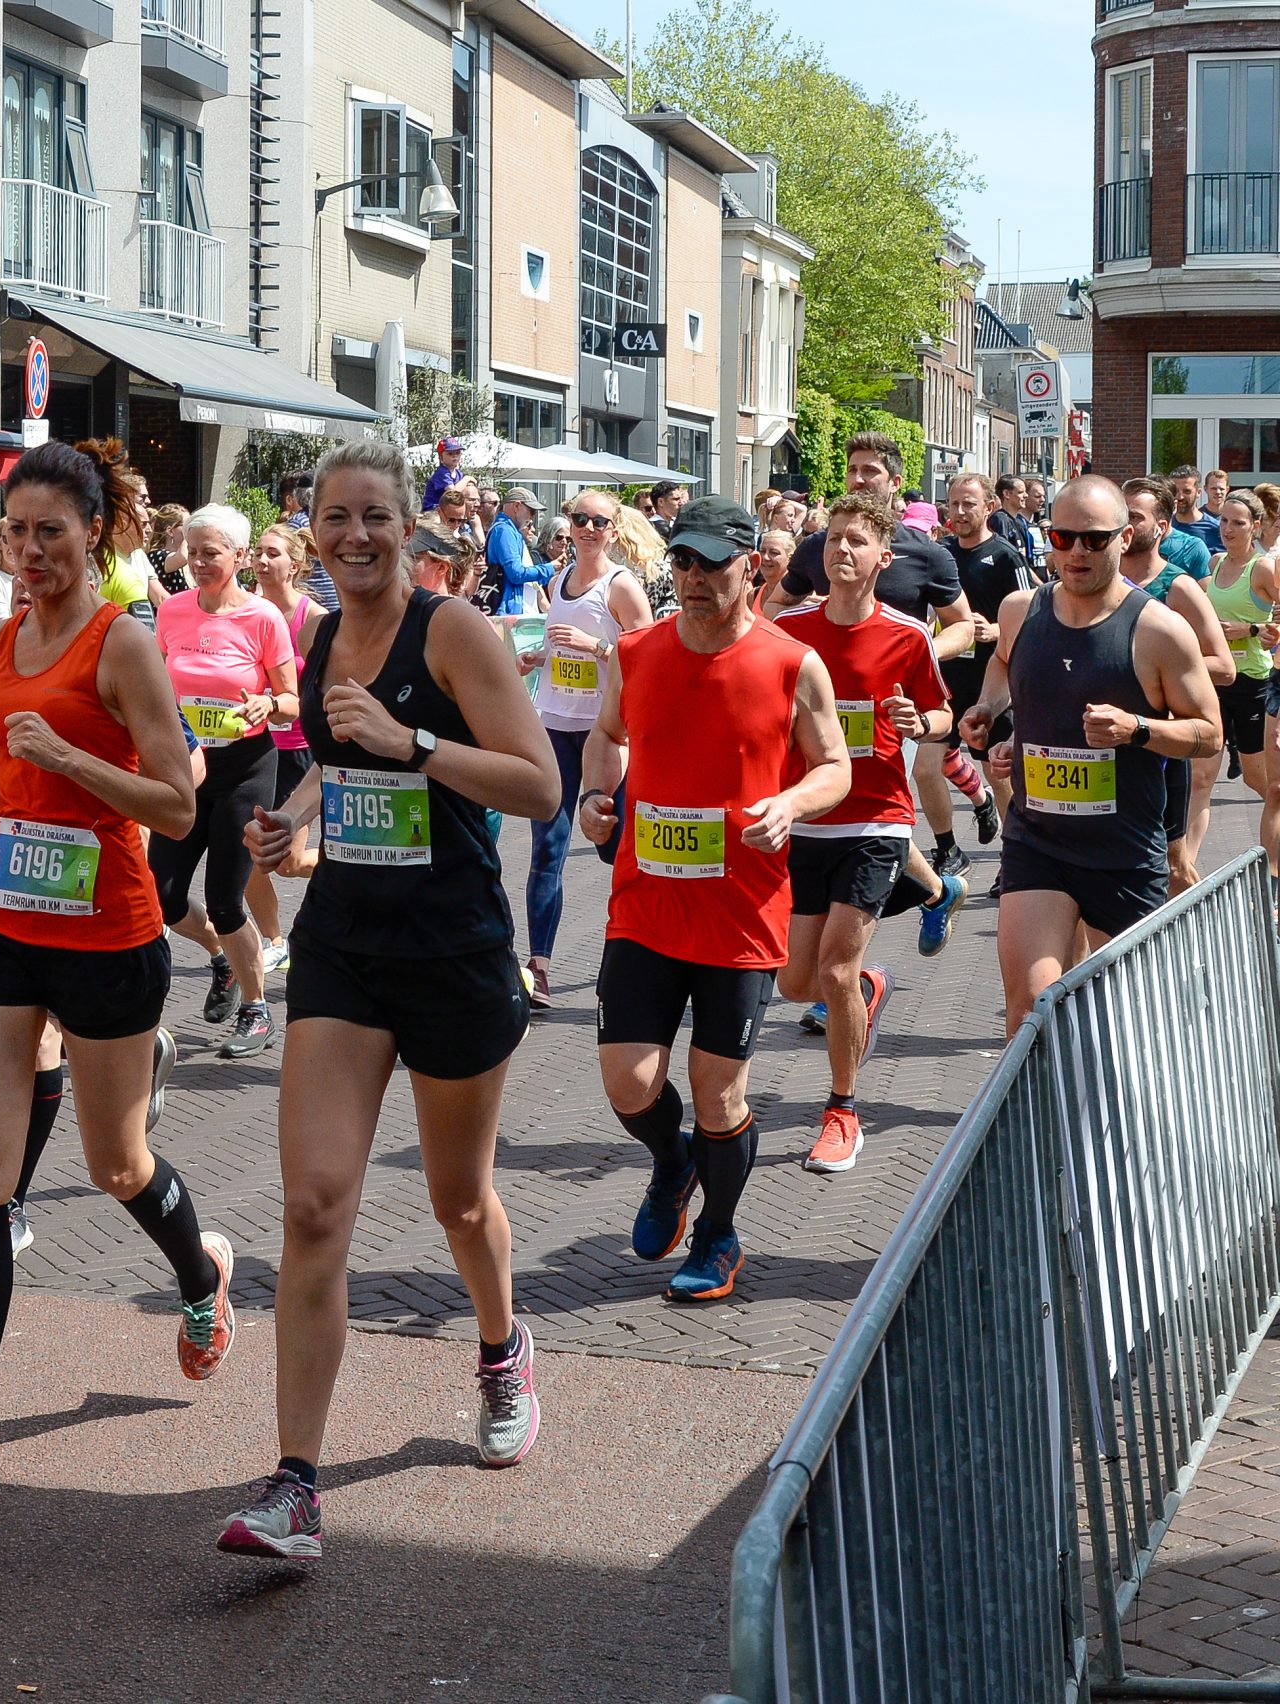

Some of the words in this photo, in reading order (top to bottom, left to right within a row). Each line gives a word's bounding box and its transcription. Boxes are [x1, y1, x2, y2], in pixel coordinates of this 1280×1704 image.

[621, 329, 659, 351] C&A
[936, 464, 957, 472] livera
[558, 661, 581, 680] 1929
[198, 709, 226, 729] 1617
[1046, 763, 1089, 790] 2341
[342, 791, 395, 829] 6195
[46, 830, 75, 843] DRAISMA
[652, 822, 699, 852] 2035
[8, 842, 65, 882] 6196
[340, 846, 372, 861] TEAMRUN
[373, 850, 383, 861] 10
[384, 850, 397, 862] KM
[665, 864, 672, 874] 10
[673, 866, 683, 875] KM
[2, 893, 36, 910] TEAMRUN
[37, 899, 47, 910] 10
[48, 900, 61, 912] KM
[739, 1018, 753, 1047] FUSION
